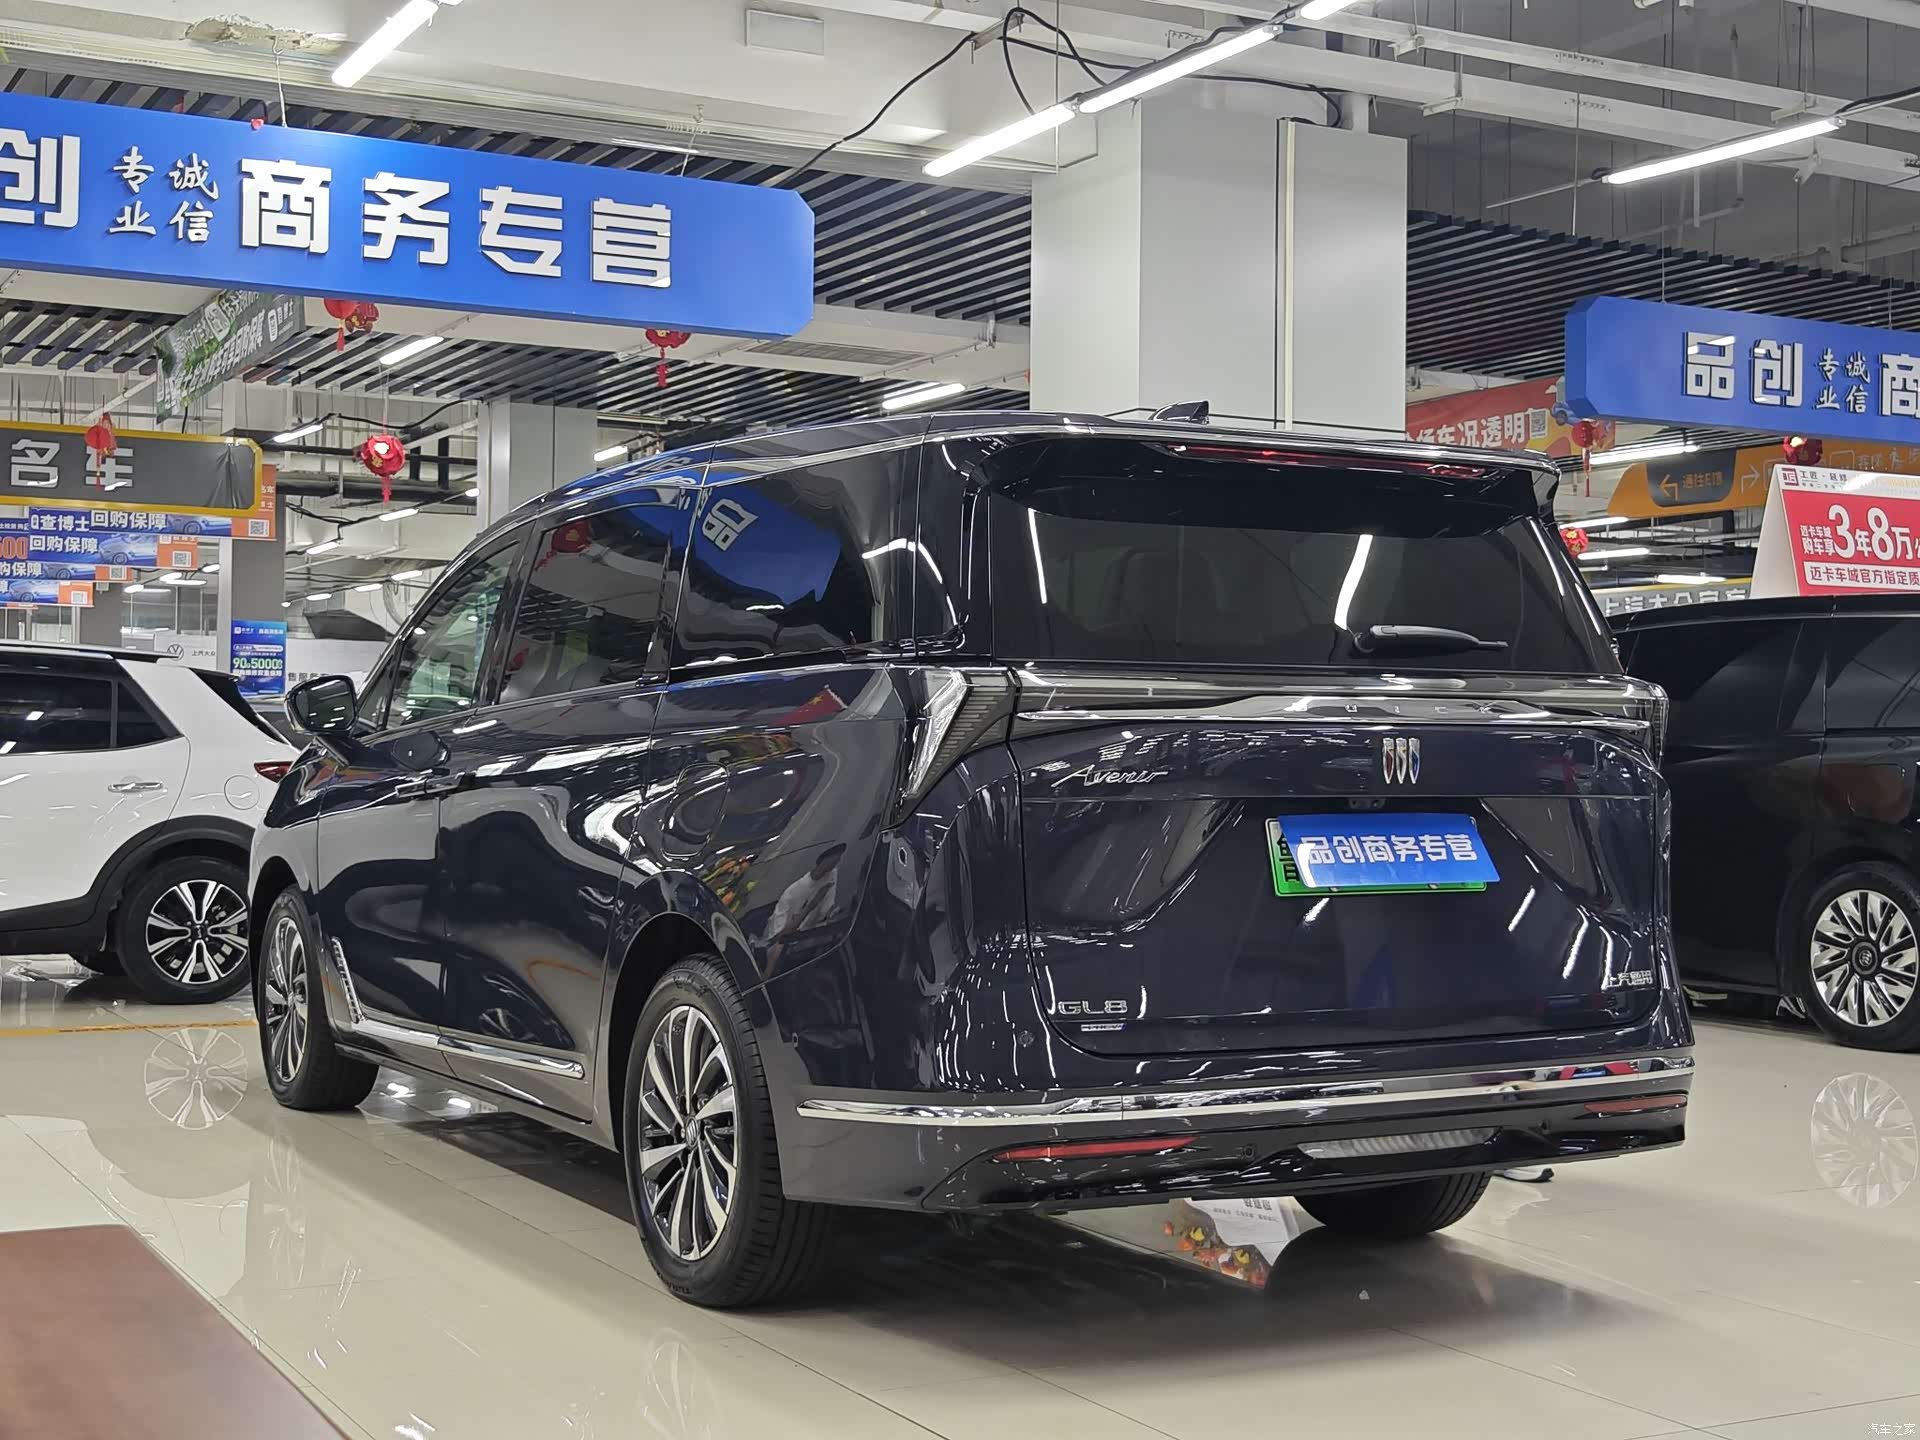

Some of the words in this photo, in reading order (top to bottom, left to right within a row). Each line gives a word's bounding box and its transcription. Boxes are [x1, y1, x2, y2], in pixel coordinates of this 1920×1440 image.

[0, 127, 80, 228] 创
[240, 158, 671, 288] 商务专营
[1686, 331, 1803, 406] 品创
[11, 439, 133, 489] 名车
[91, 510, 168, 531] 回购保障
[0, 536, 28, 559] 00
[30, 534, 99, 554] 回购保障
[1802, 537, 1835, 555] 购车享
[1051, 764, 1168, 787] Avenir
[1301, 833, 1478, 864] 品创商务专营
[1058, 1000, 1127, 1014] GL8
